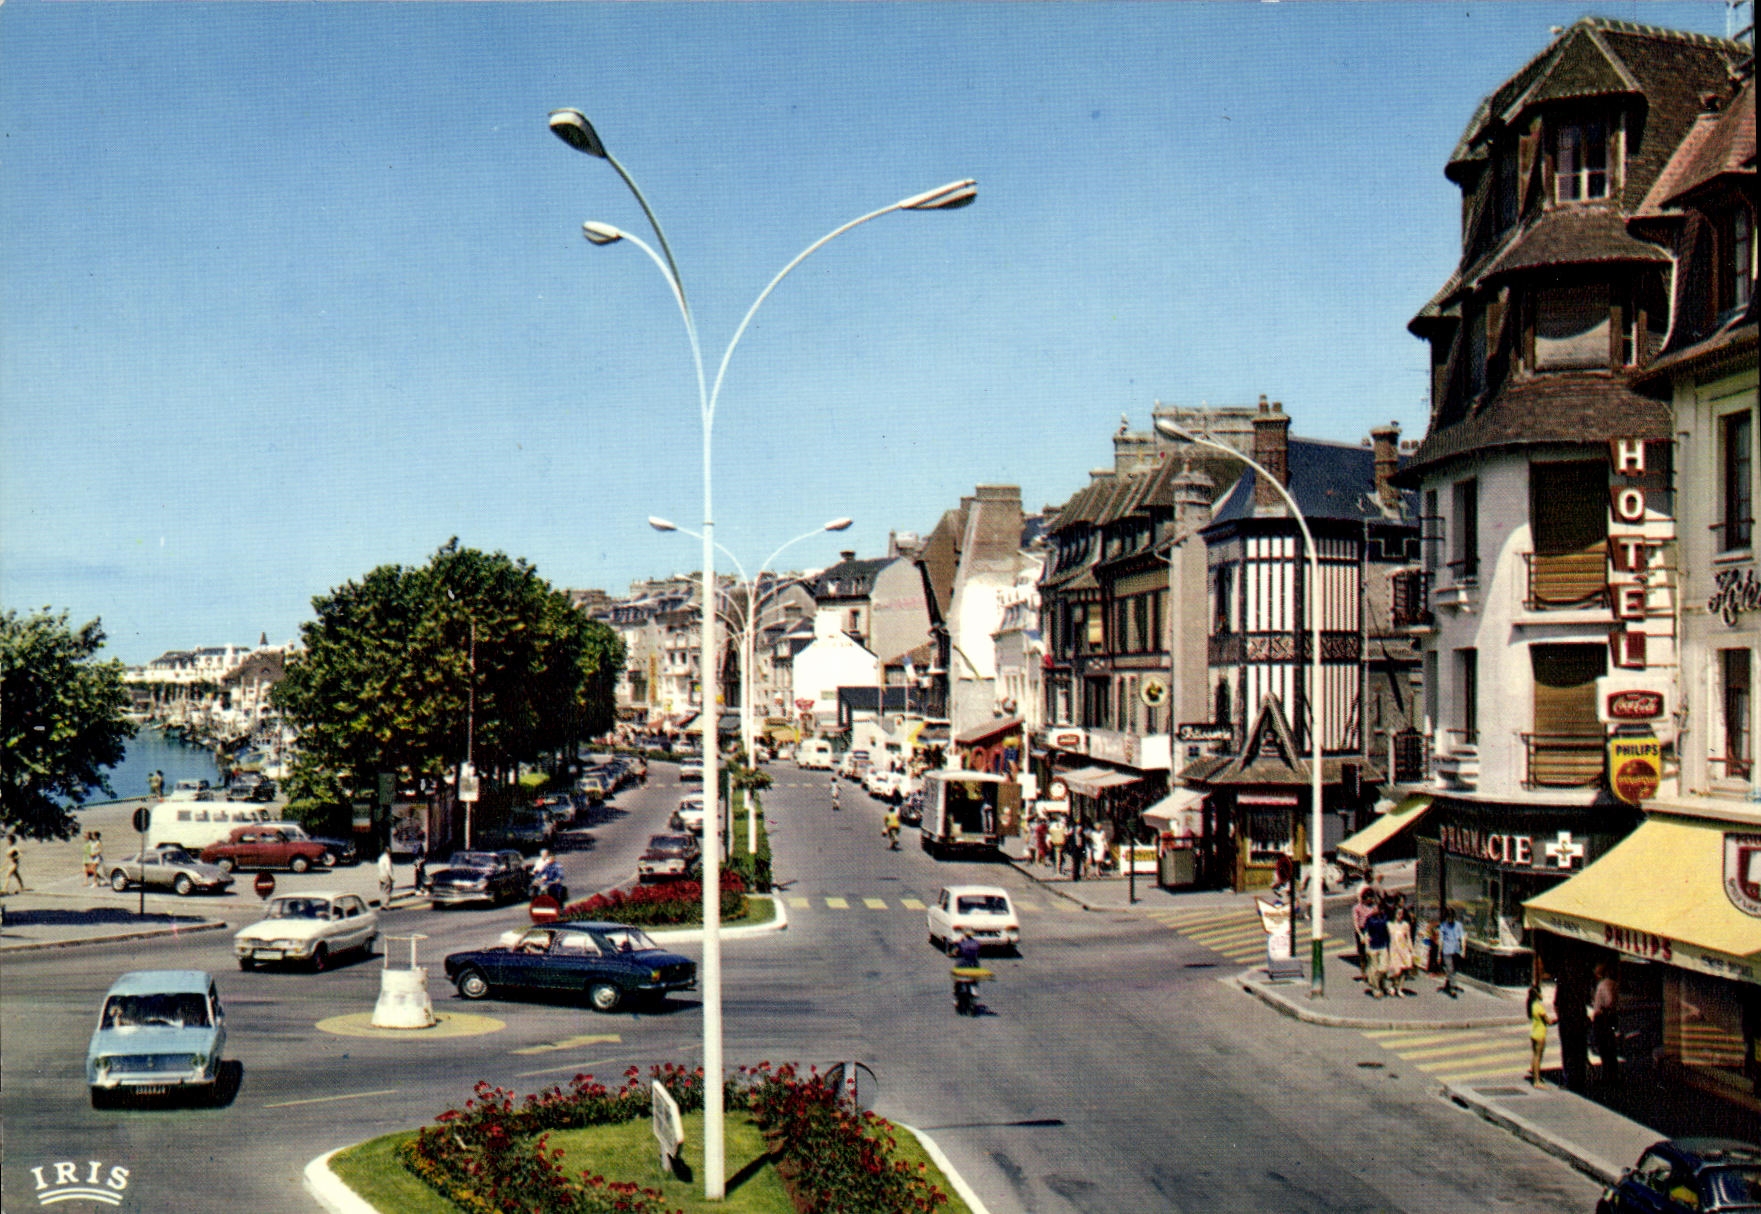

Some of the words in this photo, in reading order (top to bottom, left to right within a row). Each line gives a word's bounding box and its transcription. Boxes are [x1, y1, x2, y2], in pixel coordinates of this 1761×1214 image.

[1617, 439, 1645, 667] HOTEL
[1615, 743, 1659, 757] PHILIPS
[1440, 823, 1533, 866] PHARMACIE
[1604, 923, 1673, 961] PHILIPS
